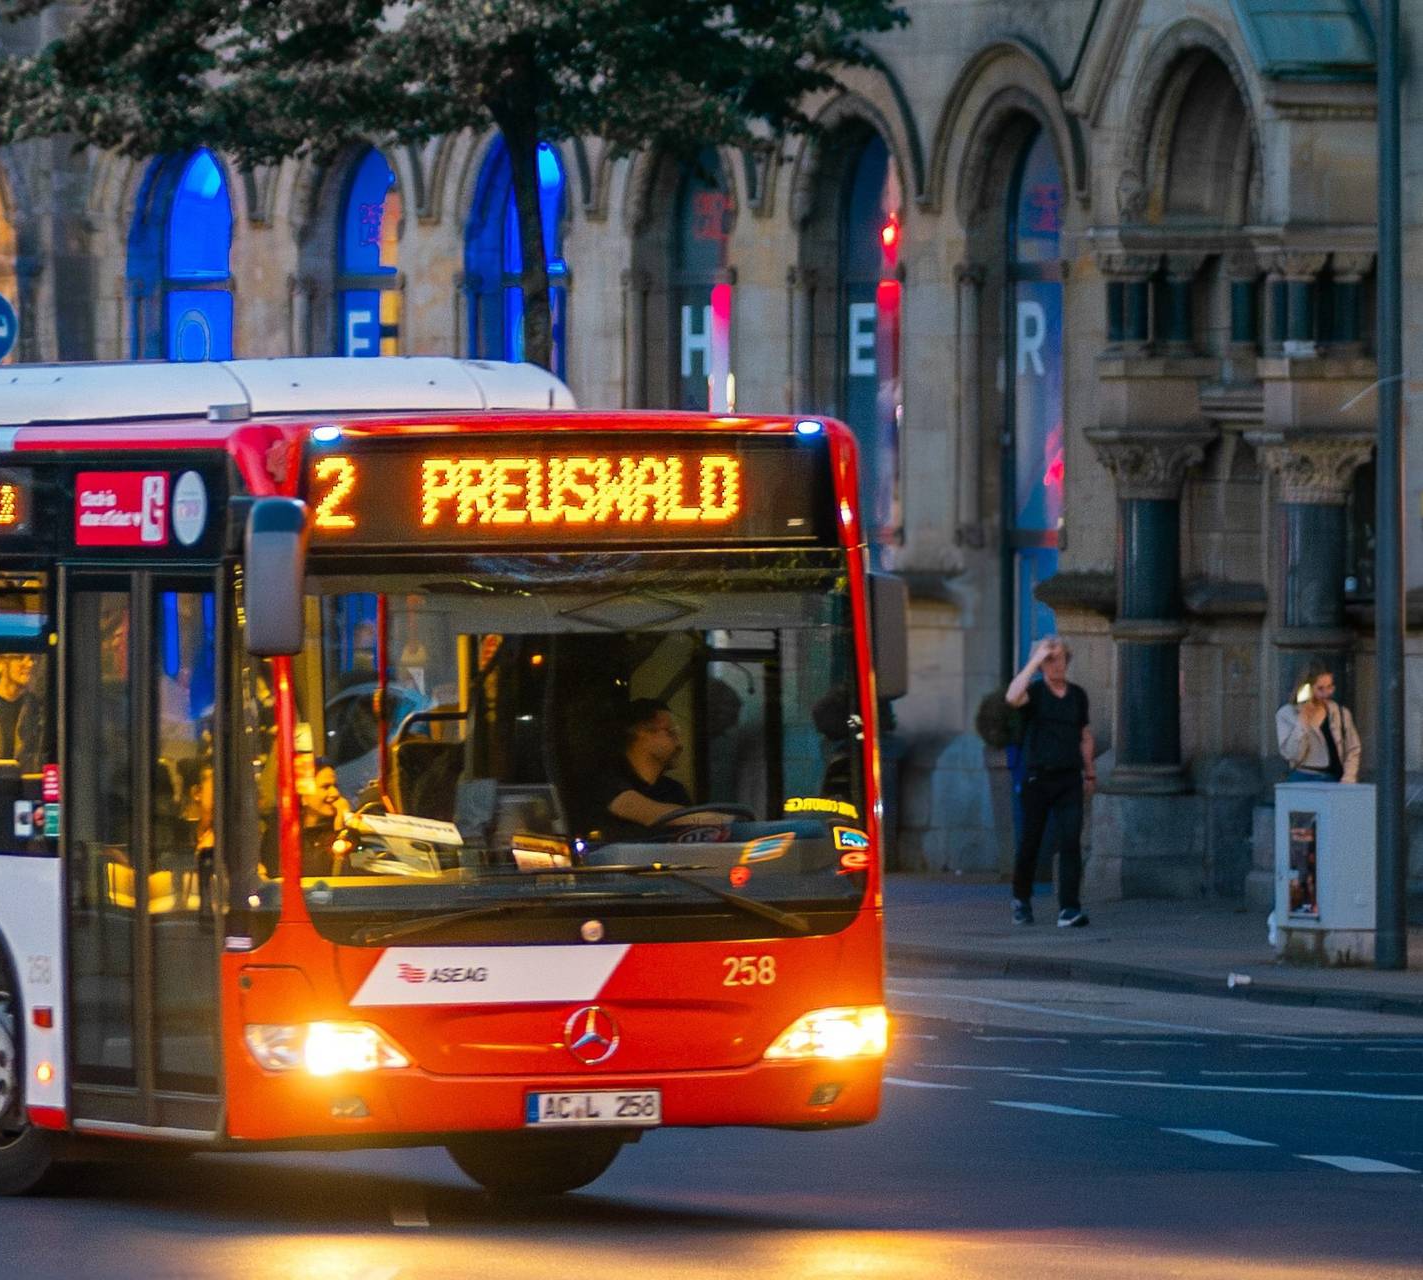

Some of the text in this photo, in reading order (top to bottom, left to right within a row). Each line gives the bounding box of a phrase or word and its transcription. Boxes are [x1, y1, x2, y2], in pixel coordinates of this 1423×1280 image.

[316, 457, 739, 527] 2 PREUSWALD
[427, 967, 489, 983] ASEAG
[722, 956, 776, 987] 258
[616, 1095, 655, 1117] 258
